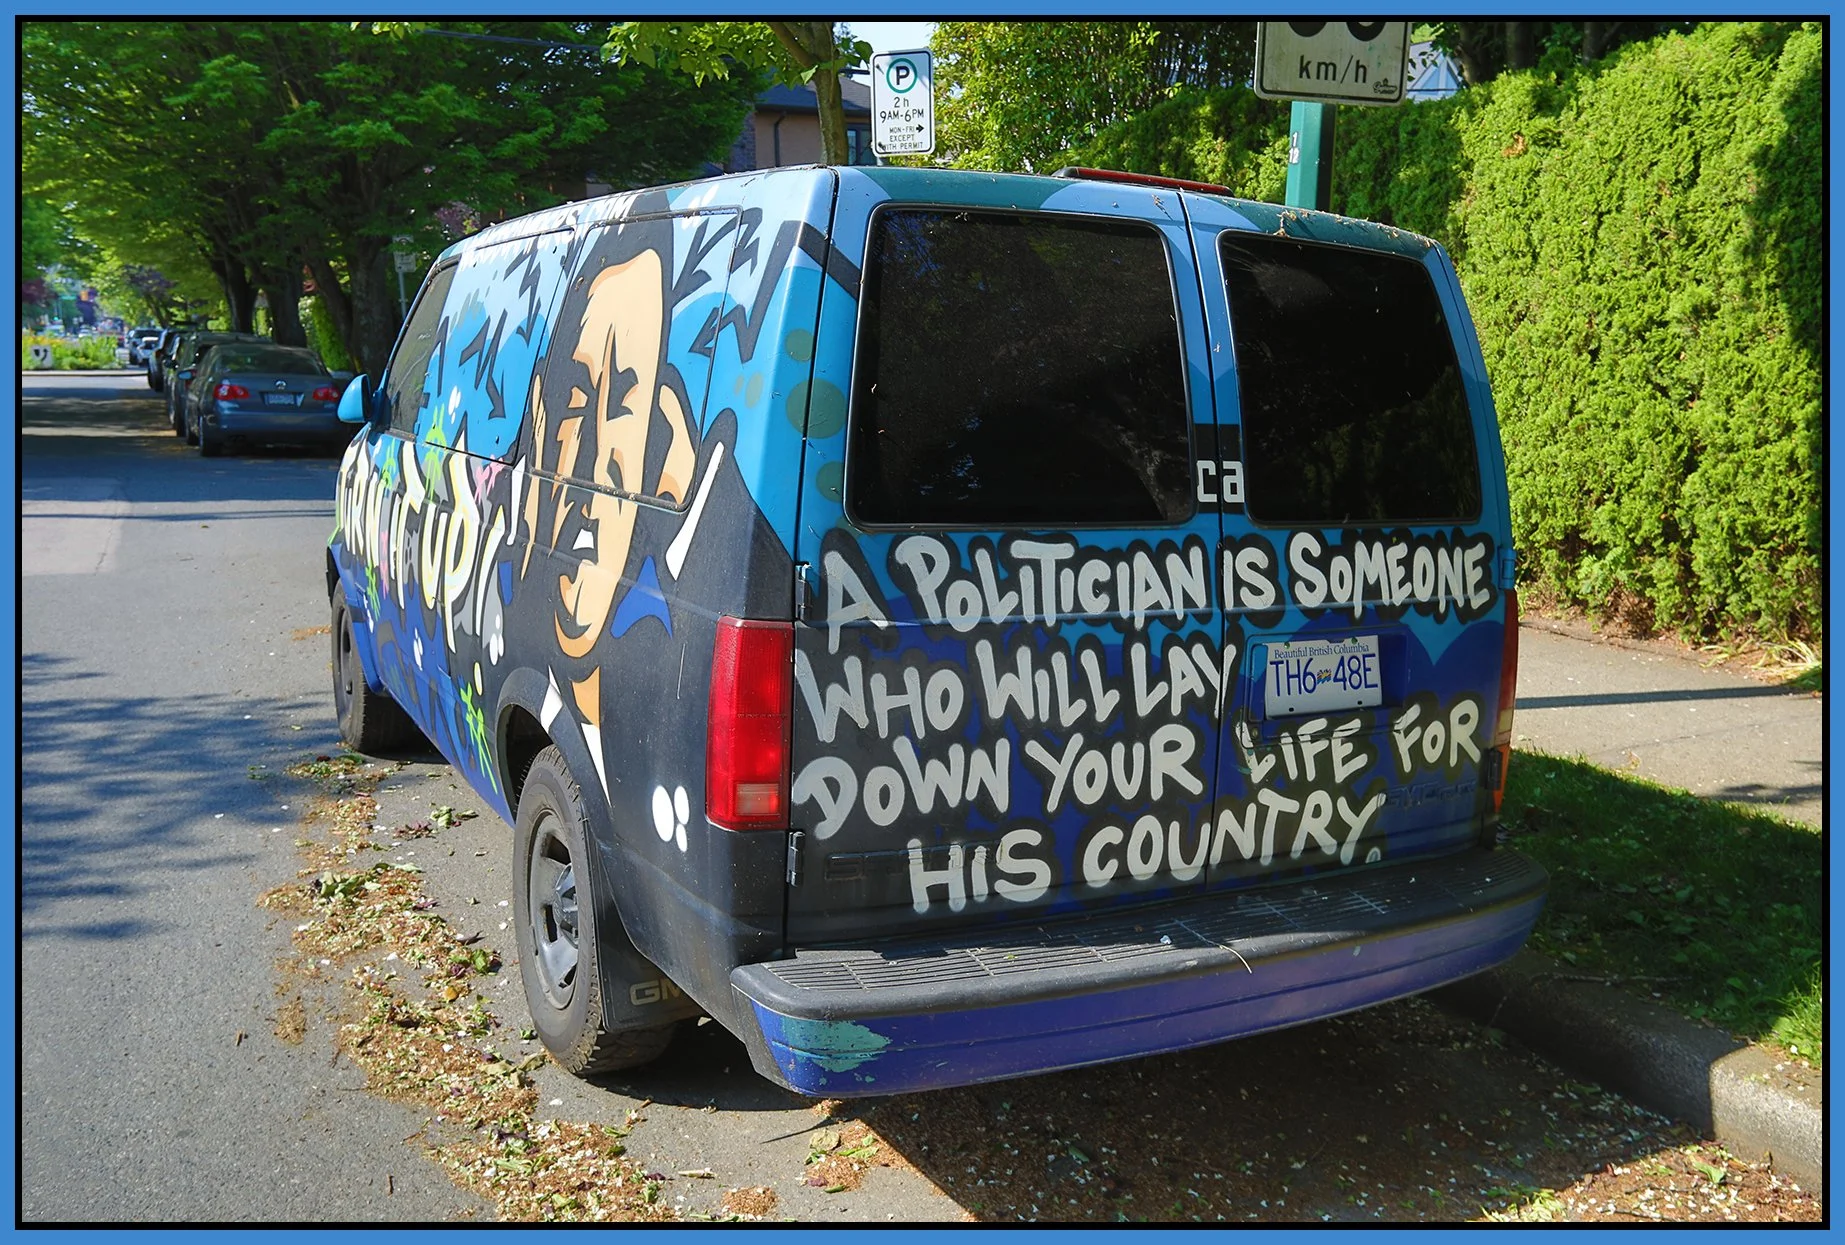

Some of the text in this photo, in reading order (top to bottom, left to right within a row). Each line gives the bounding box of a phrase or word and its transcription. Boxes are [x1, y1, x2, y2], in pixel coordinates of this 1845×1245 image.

[895, 65, 910, 86] P
[1298, 54, 1368, 84] km/h
[893, 96, 909, 108] 2 h
[879, 108, 925, 123] 9AM-6PM
[889, 125, 915, 134] MON-FRI
[889, 133, 915, 143] EXCEPT
[899, 141, 924, 151] PERMIT
[1291, 131, 1298, 147] 1
[1289, 147, 1300, 164] 12
[824, 531, 1490, 654] A POLITICIAN IS SOMEONE
[1274, 643, 1370, 659] Beautiful British Columbia
[1269, 653, 1379, 697] TH6 48E
[795, 638, 1237, 743] WHO WILL LAY
[792, 699, 1482, 840] DOWN YOUR LIFE FOR
[907, 828, 1052, 914] HIS
[1082, 788, 1387, 888] COUNTRY.
